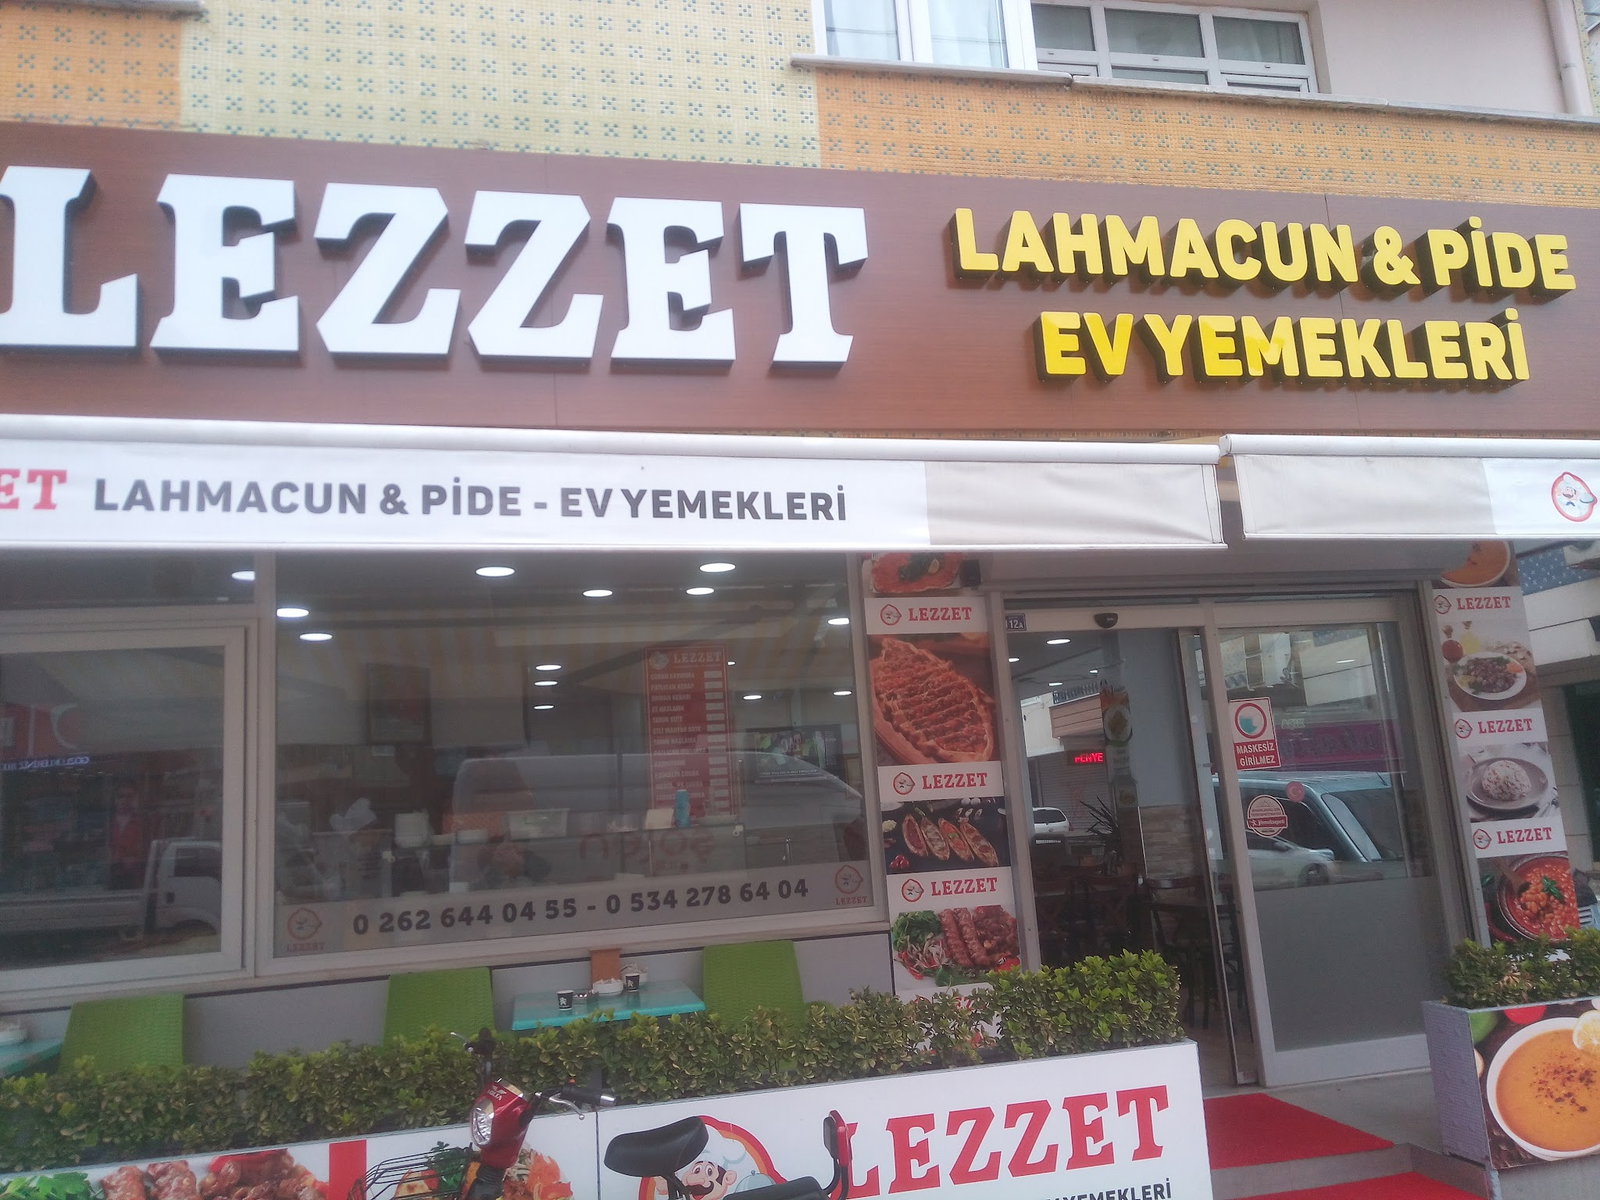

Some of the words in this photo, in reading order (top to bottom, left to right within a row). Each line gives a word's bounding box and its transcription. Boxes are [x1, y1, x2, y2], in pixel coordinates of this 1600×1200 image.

[952, 206, 1357, 284] LAHMACUN
[1371, 225, 1421, 286] &
[1426, 215, 1577, 291] PİDE
[0, 165, 869, 366] LEZZET
[1039, 311, 1133, 377] EV
[1143, 307, 1532, 383] YEMEKLERİ
[94, 477, 367, 515] LAHMACUN
[379, 482, 408, 516] &
[422, 476, 521, 519] PİDE
[561, 487, 611, 520] EV
[622, 485, 848, 523] YEMEKLERİ
[1456, 596, 1511, 610] LEZZET
[908, 606, 973, 623] LEZZET
[1477, 718, 1533, 734] LEZZET
[1236, 741, 1275, 754] MASKESİZ
[1239, 753, 1276, 767] GİRİLMEZ
[922, 772, 988, 790] LEZZET
[1496, 827, 1552, 843] LEZZET
[931, 877, 998, 897] LEZZET
[353, 914, 369, 935] 0
[379, 909, 431, 933] 262
[440, 904, 493, 928] 644
[502, 902, 536, 923] 04
[545, 898, 577, 920] 55
[606, 894, 620, 914] 0
[630, 889, 678, 912] 534
[686, 885, 731, 907] 278
[740, 881, 769, 901] 64
[778, 879, 808, 899] 04
[835, 896, 867, 905] LEZZET
[831, 1084, 1169, 1199] LEZZET
